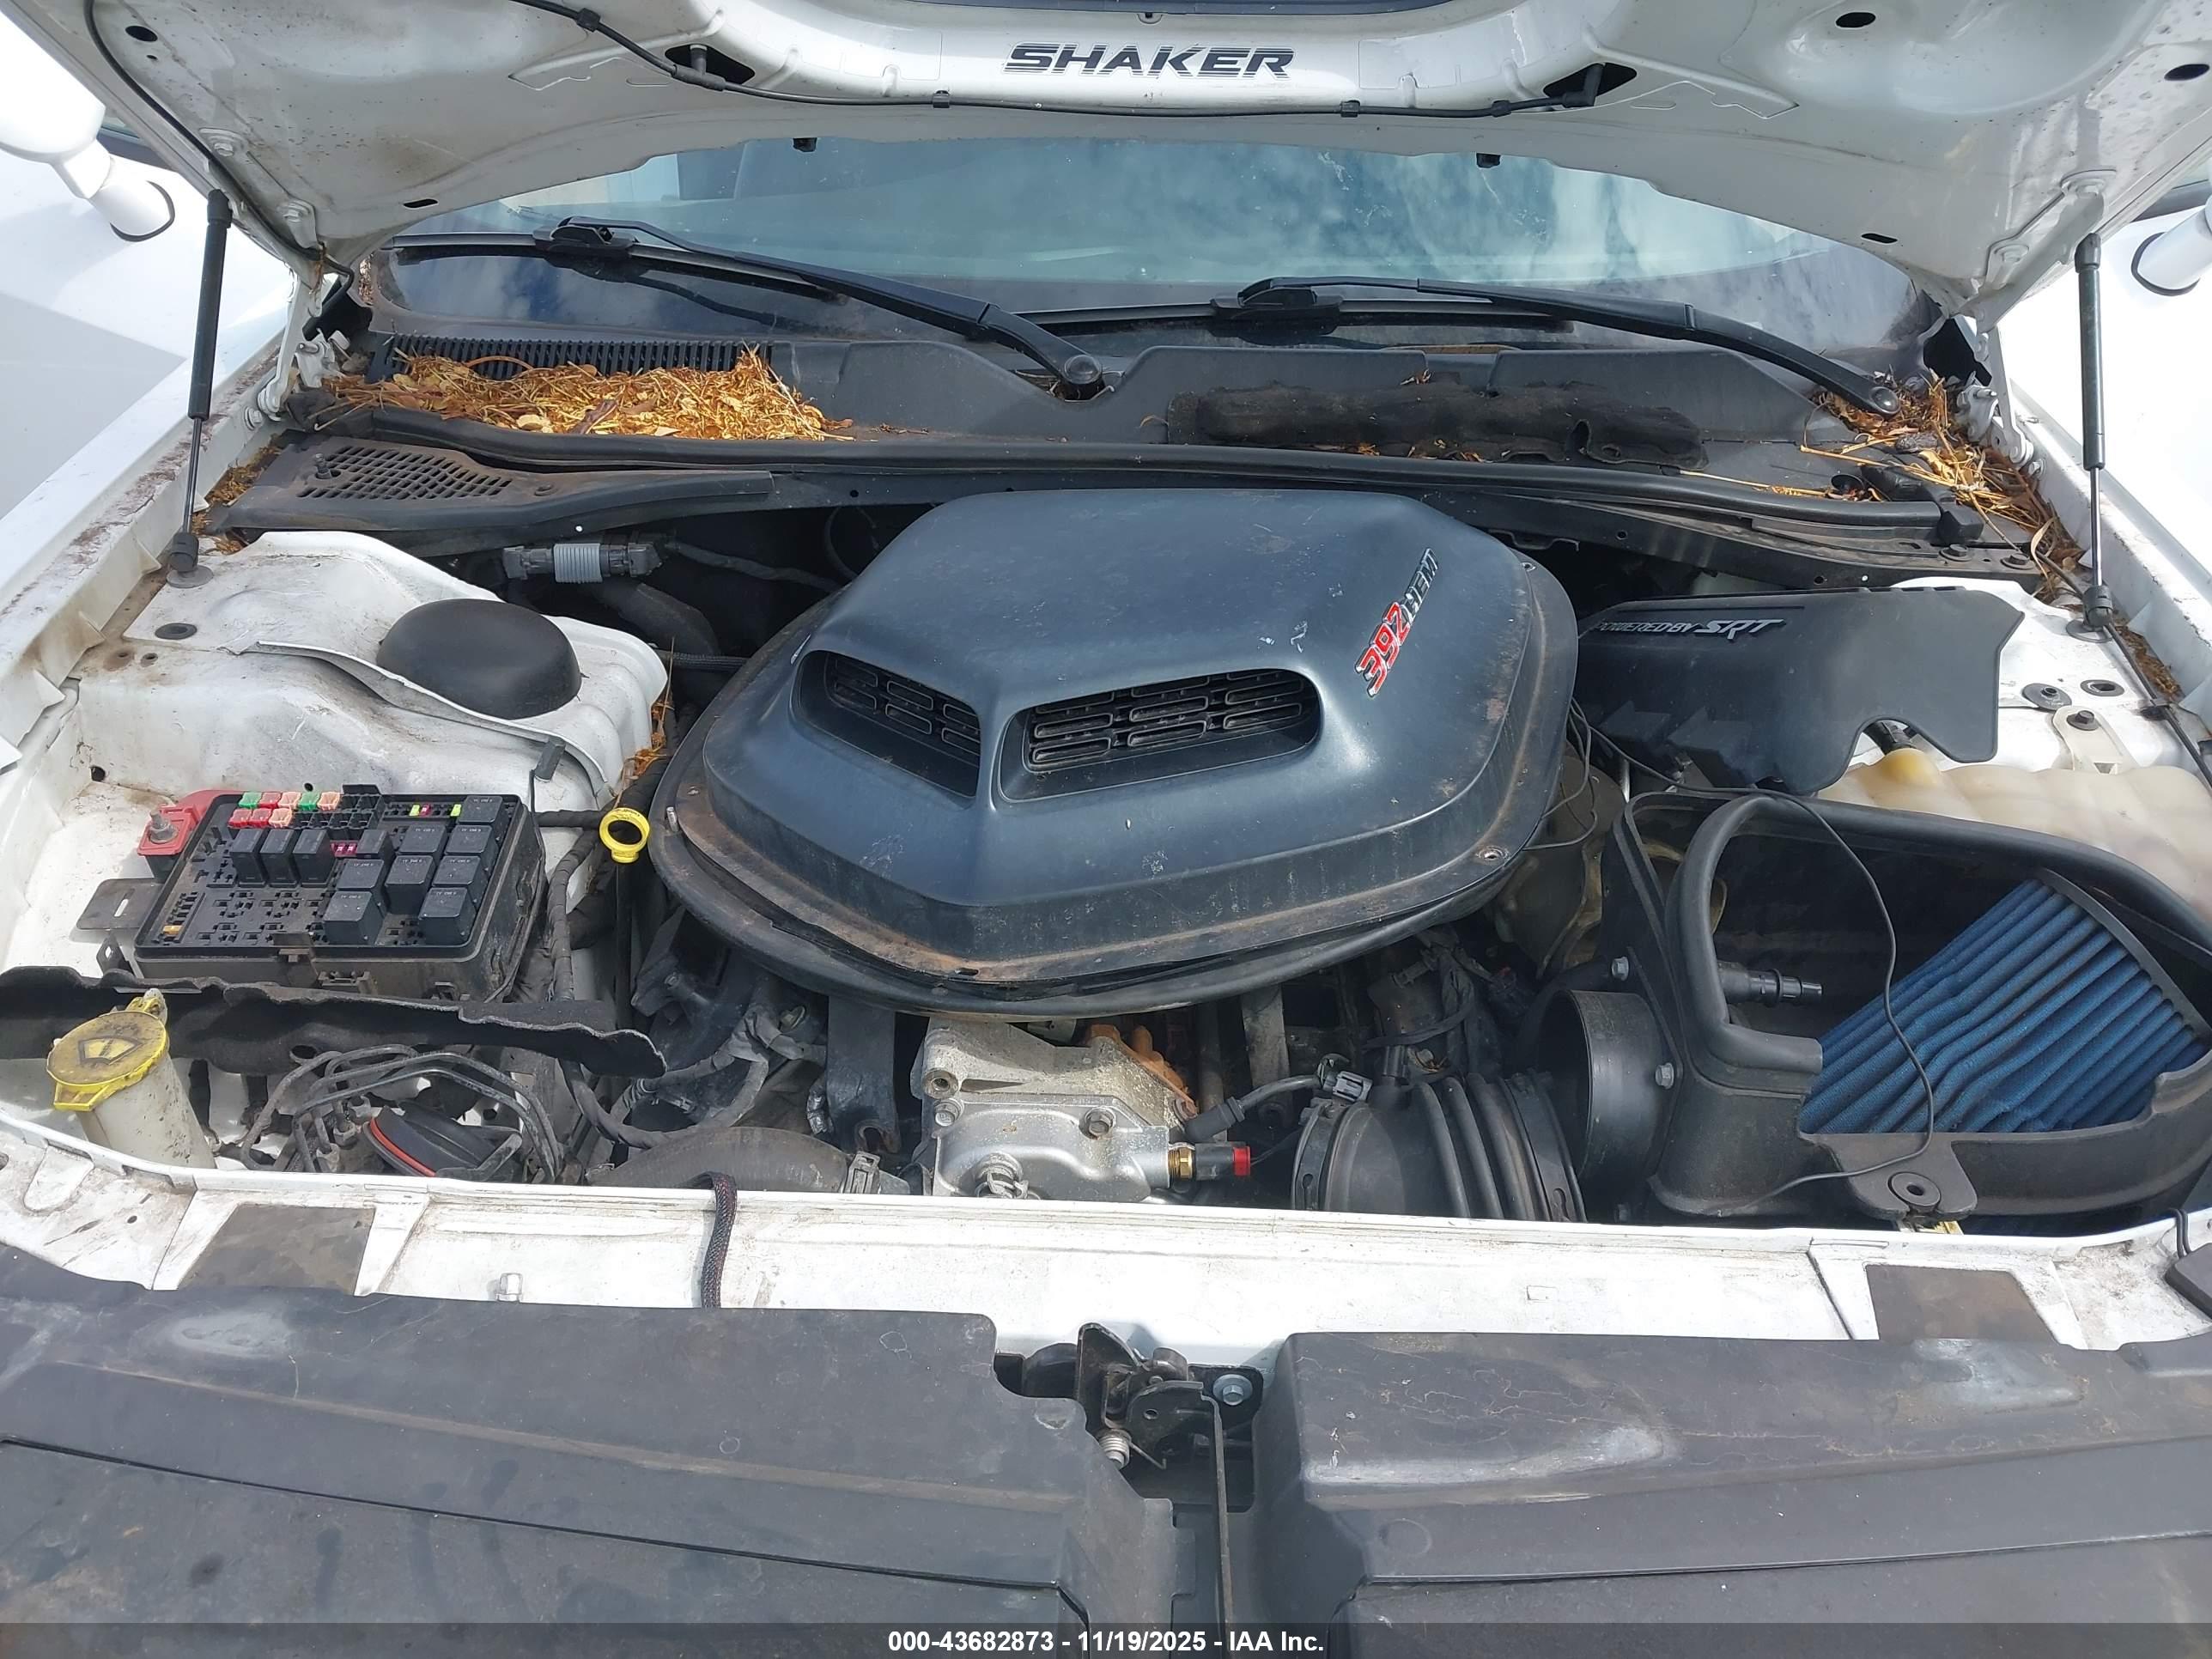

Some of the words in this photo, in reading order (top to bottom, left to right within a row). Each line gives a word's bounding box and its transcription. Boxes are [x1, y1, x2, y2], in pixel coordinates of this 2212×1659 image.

[1003, 42, 1295, 79] SHAKER
[1667, 622, 1699, 634] BY
[1696, 619, 1785, 640] SRT
[1355, 602, 1411, 697] 392
